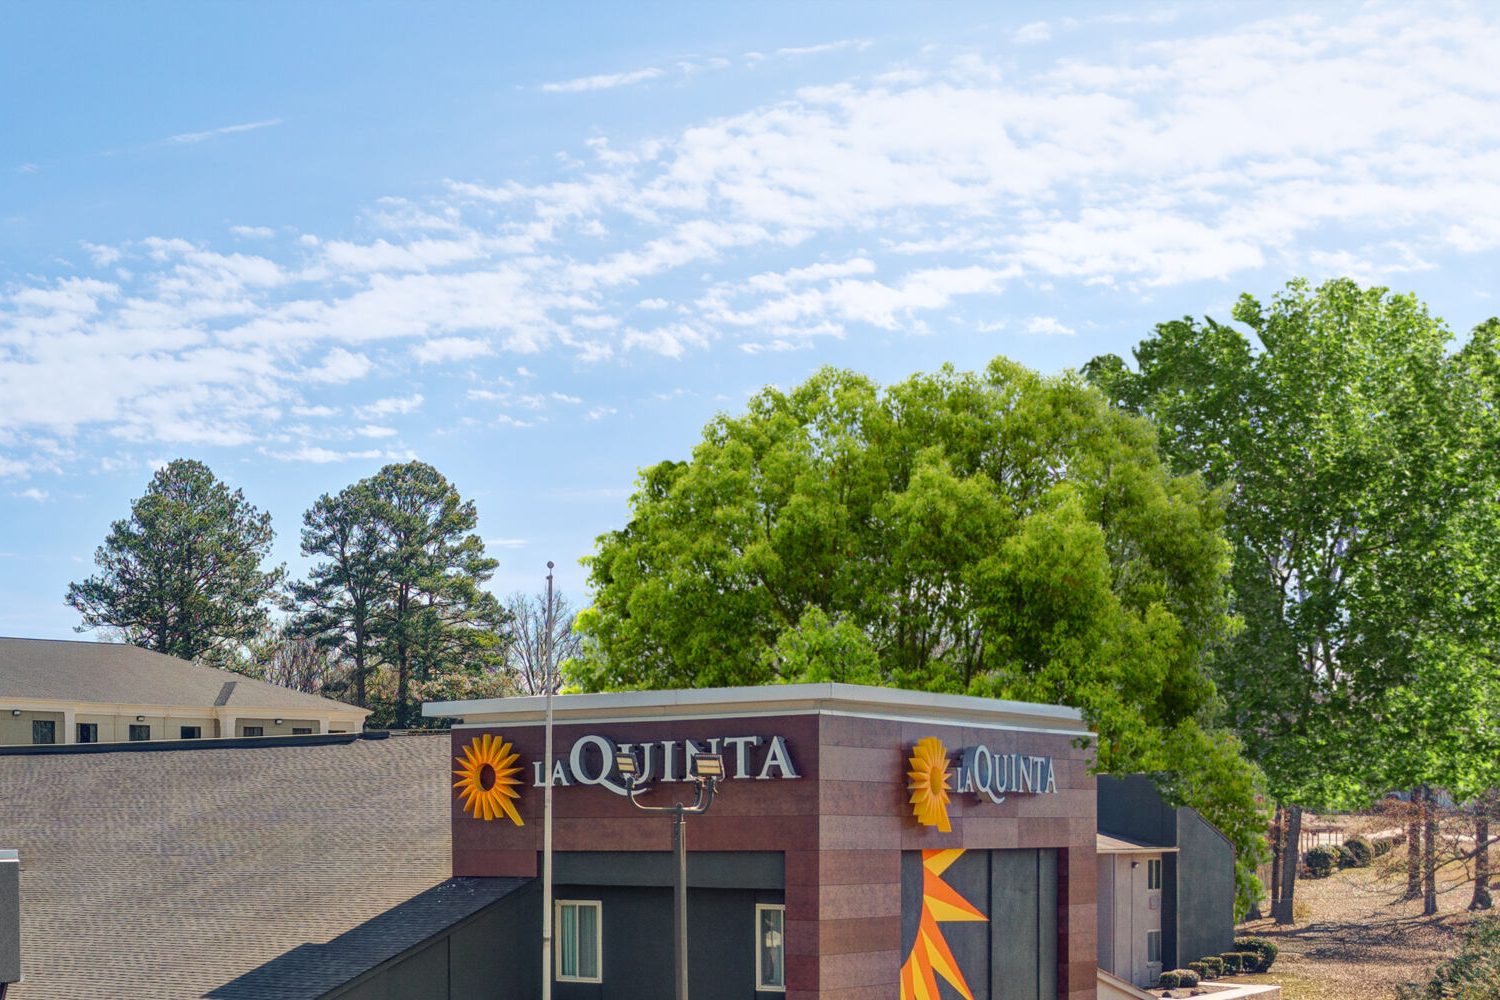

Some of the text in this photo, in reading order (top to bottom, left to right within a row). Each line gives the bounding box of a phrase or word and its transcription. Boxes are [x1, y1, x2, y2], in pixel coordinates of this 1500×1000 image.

[532, 759, 570, 787] LA
[956, 745, 1058, 804] LA QUINTA
